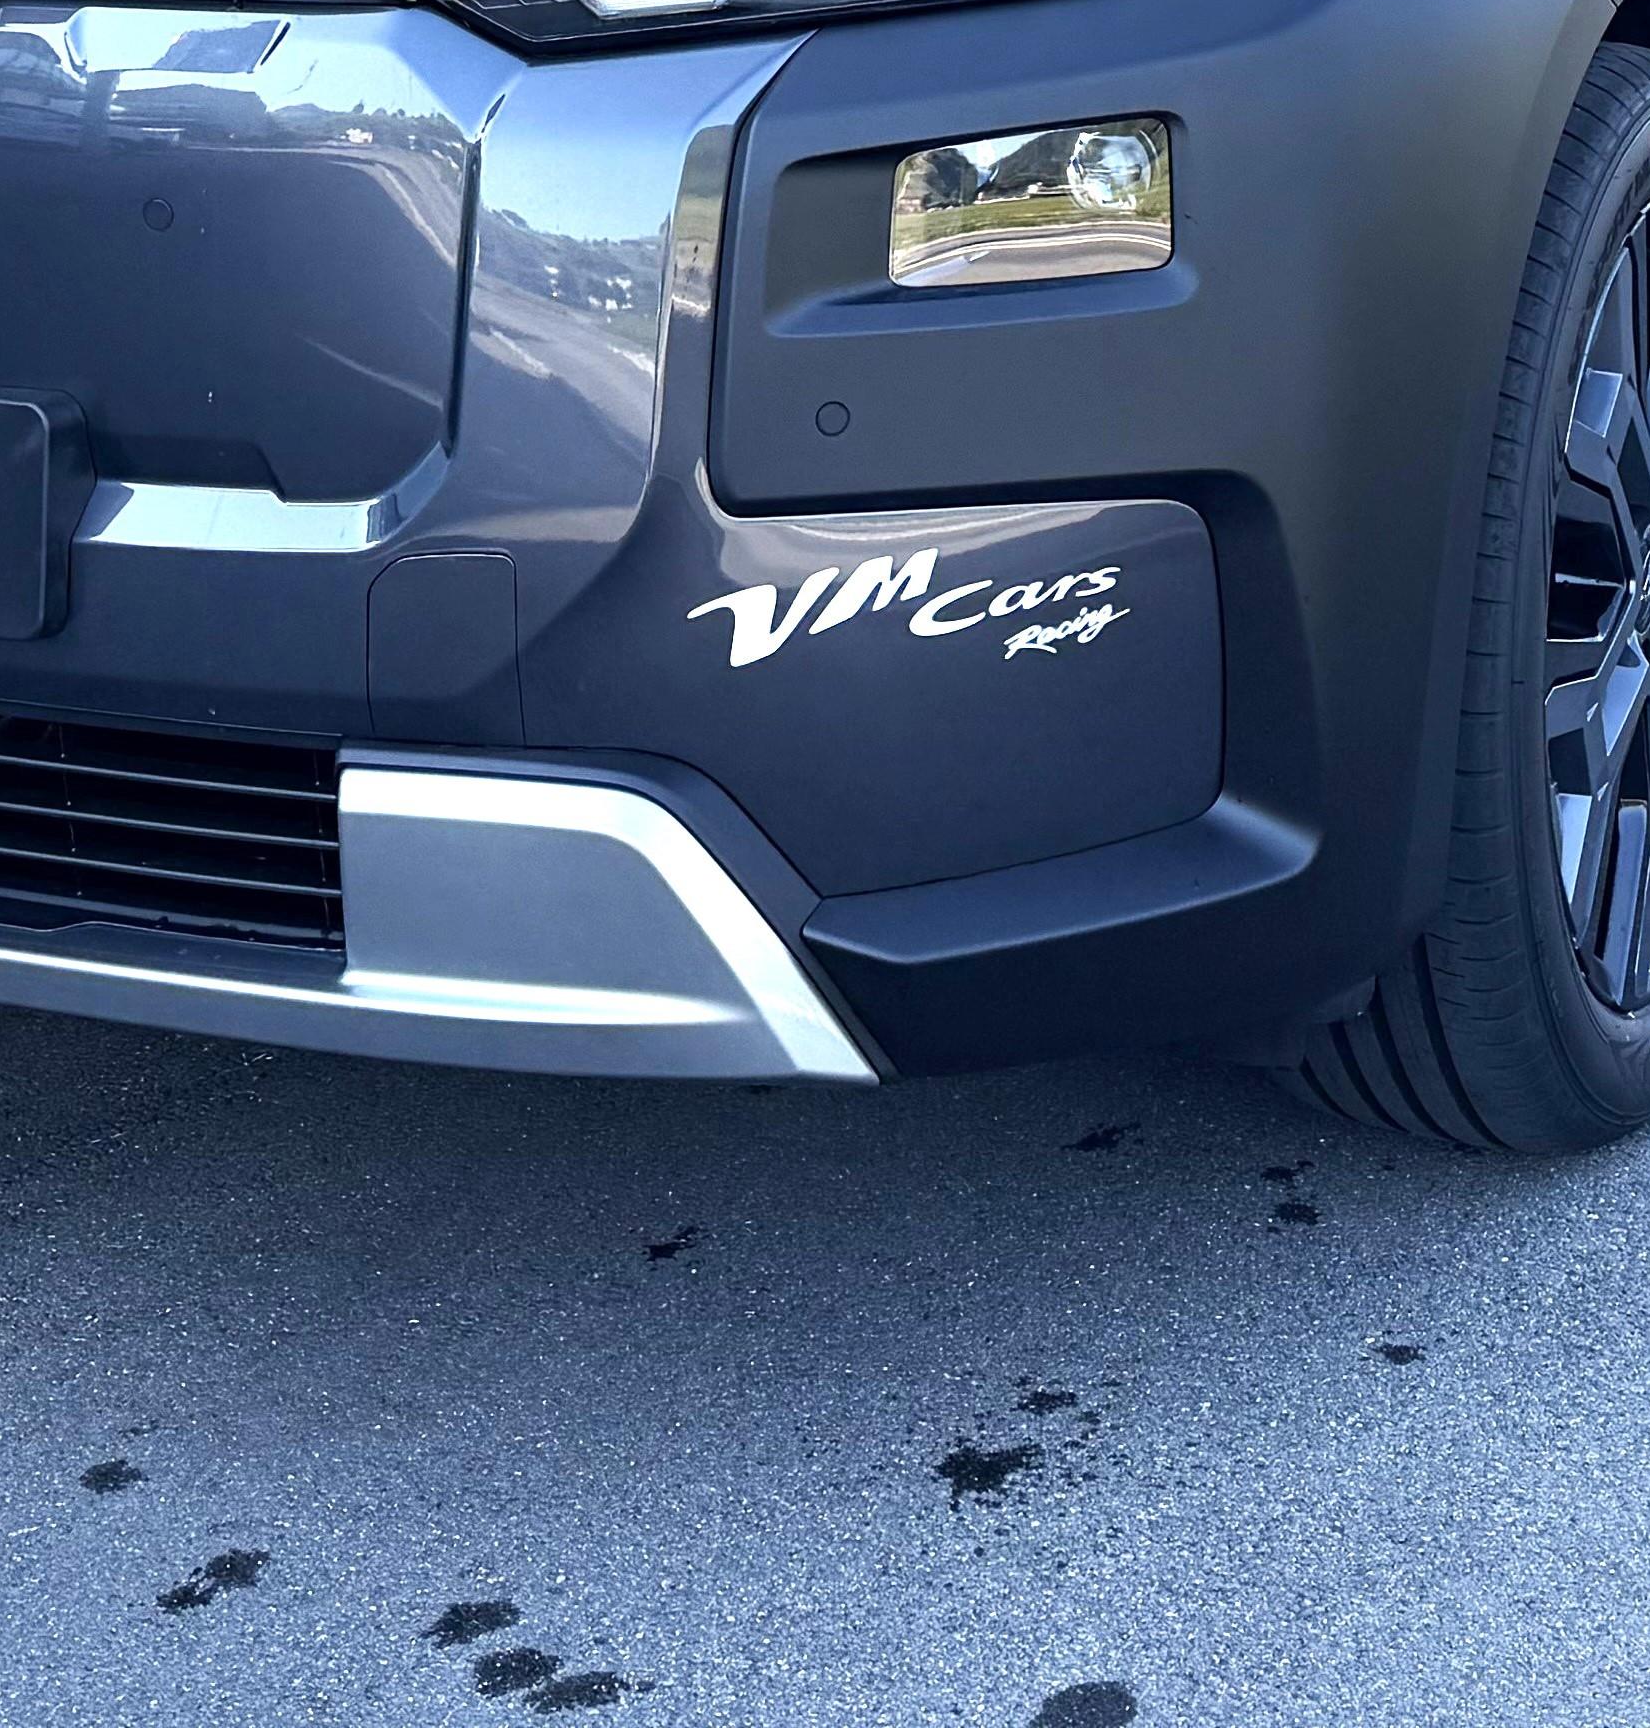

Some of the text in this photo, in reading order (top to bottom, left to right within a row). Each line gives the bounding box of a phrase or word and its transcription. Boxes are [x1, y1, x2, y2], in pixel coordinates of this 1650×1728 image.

[686, 547, 1121, 668] VM Cars
[1003, 603, 1131, 660] Racing
